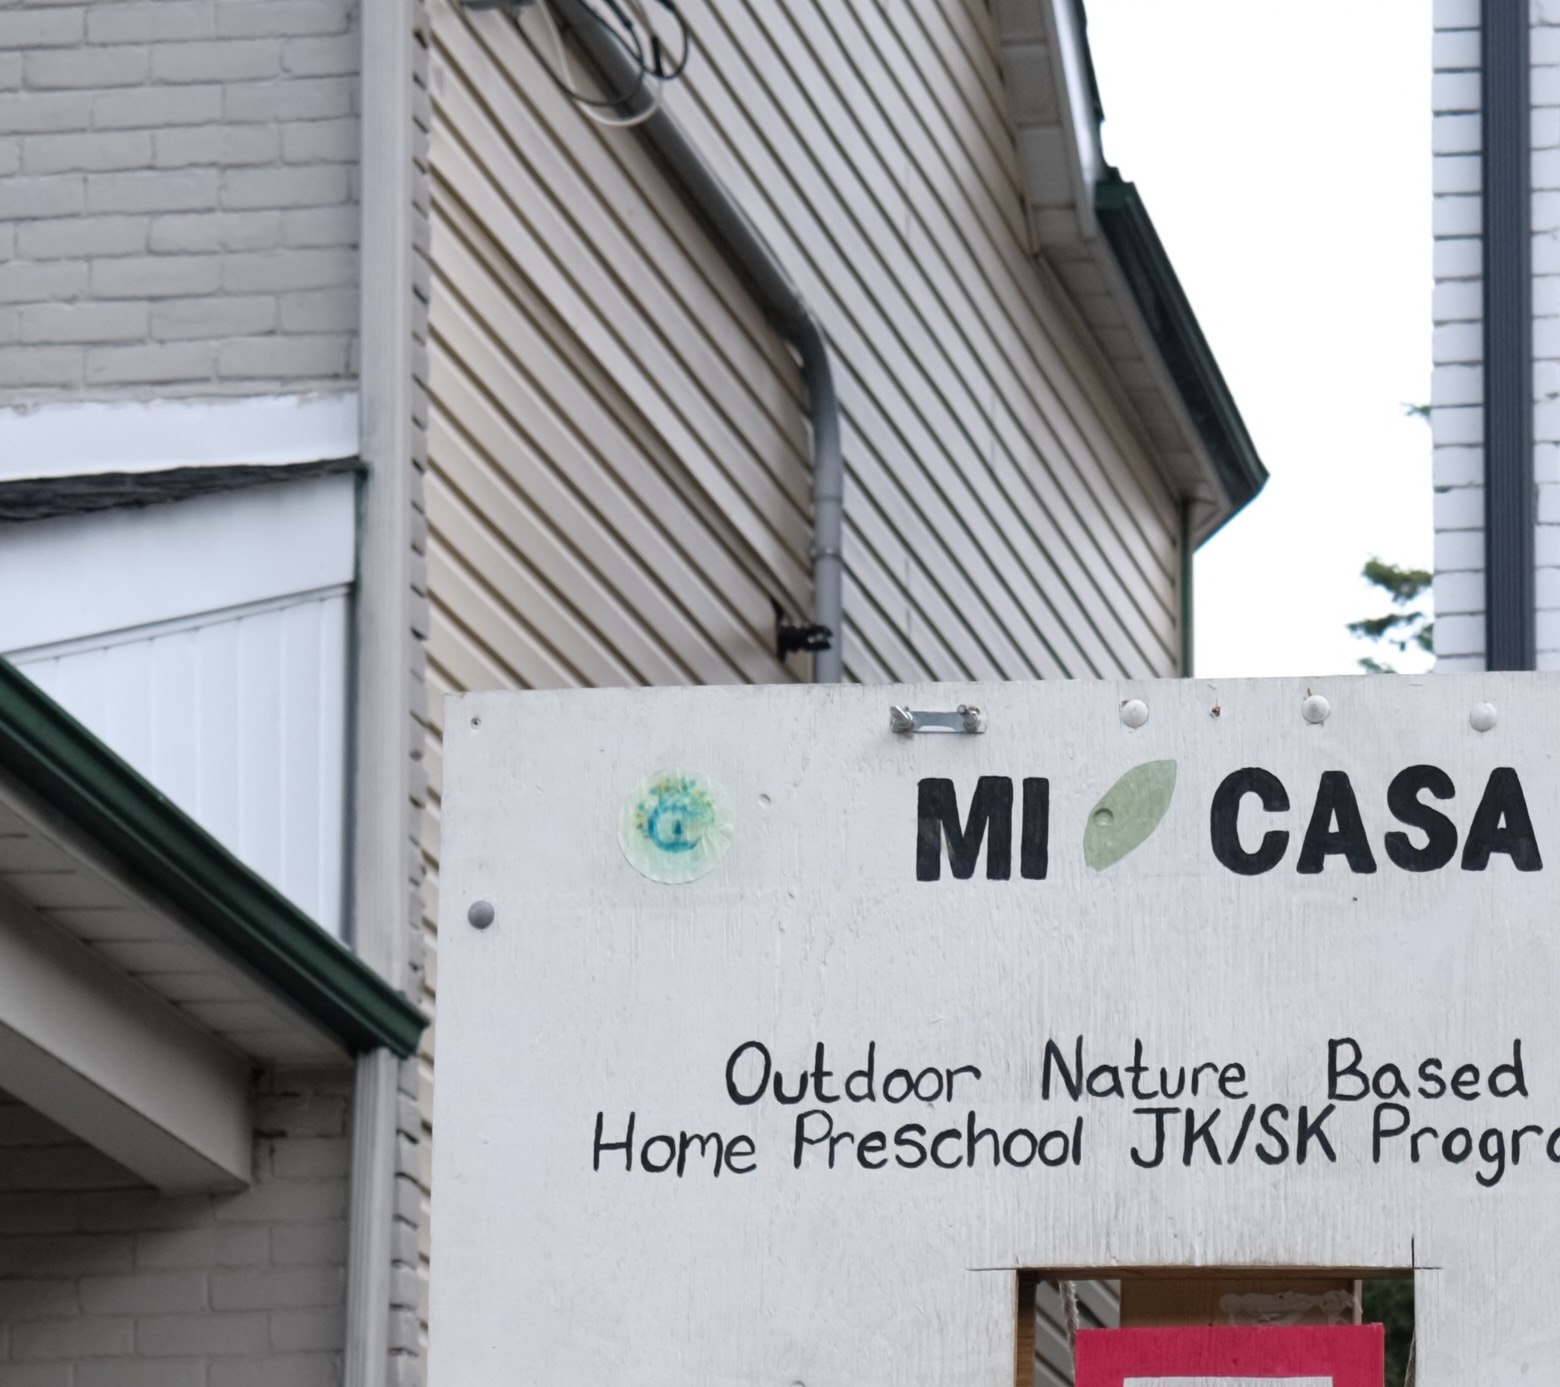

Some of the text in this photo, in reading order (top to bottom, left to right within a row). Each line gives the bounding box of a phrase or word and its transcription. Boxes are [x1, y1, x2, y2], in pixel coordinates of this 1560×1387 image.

[916, 764, 1544, 882] MI CASA
[724, 1034, 1529, 1104] Outdoor Nature Based
[592, 1111, 759, 1179] Home
[791, 1108, 1085, 1170] Preschool
[1128, 1103, 1339, 1170] JK/SK
